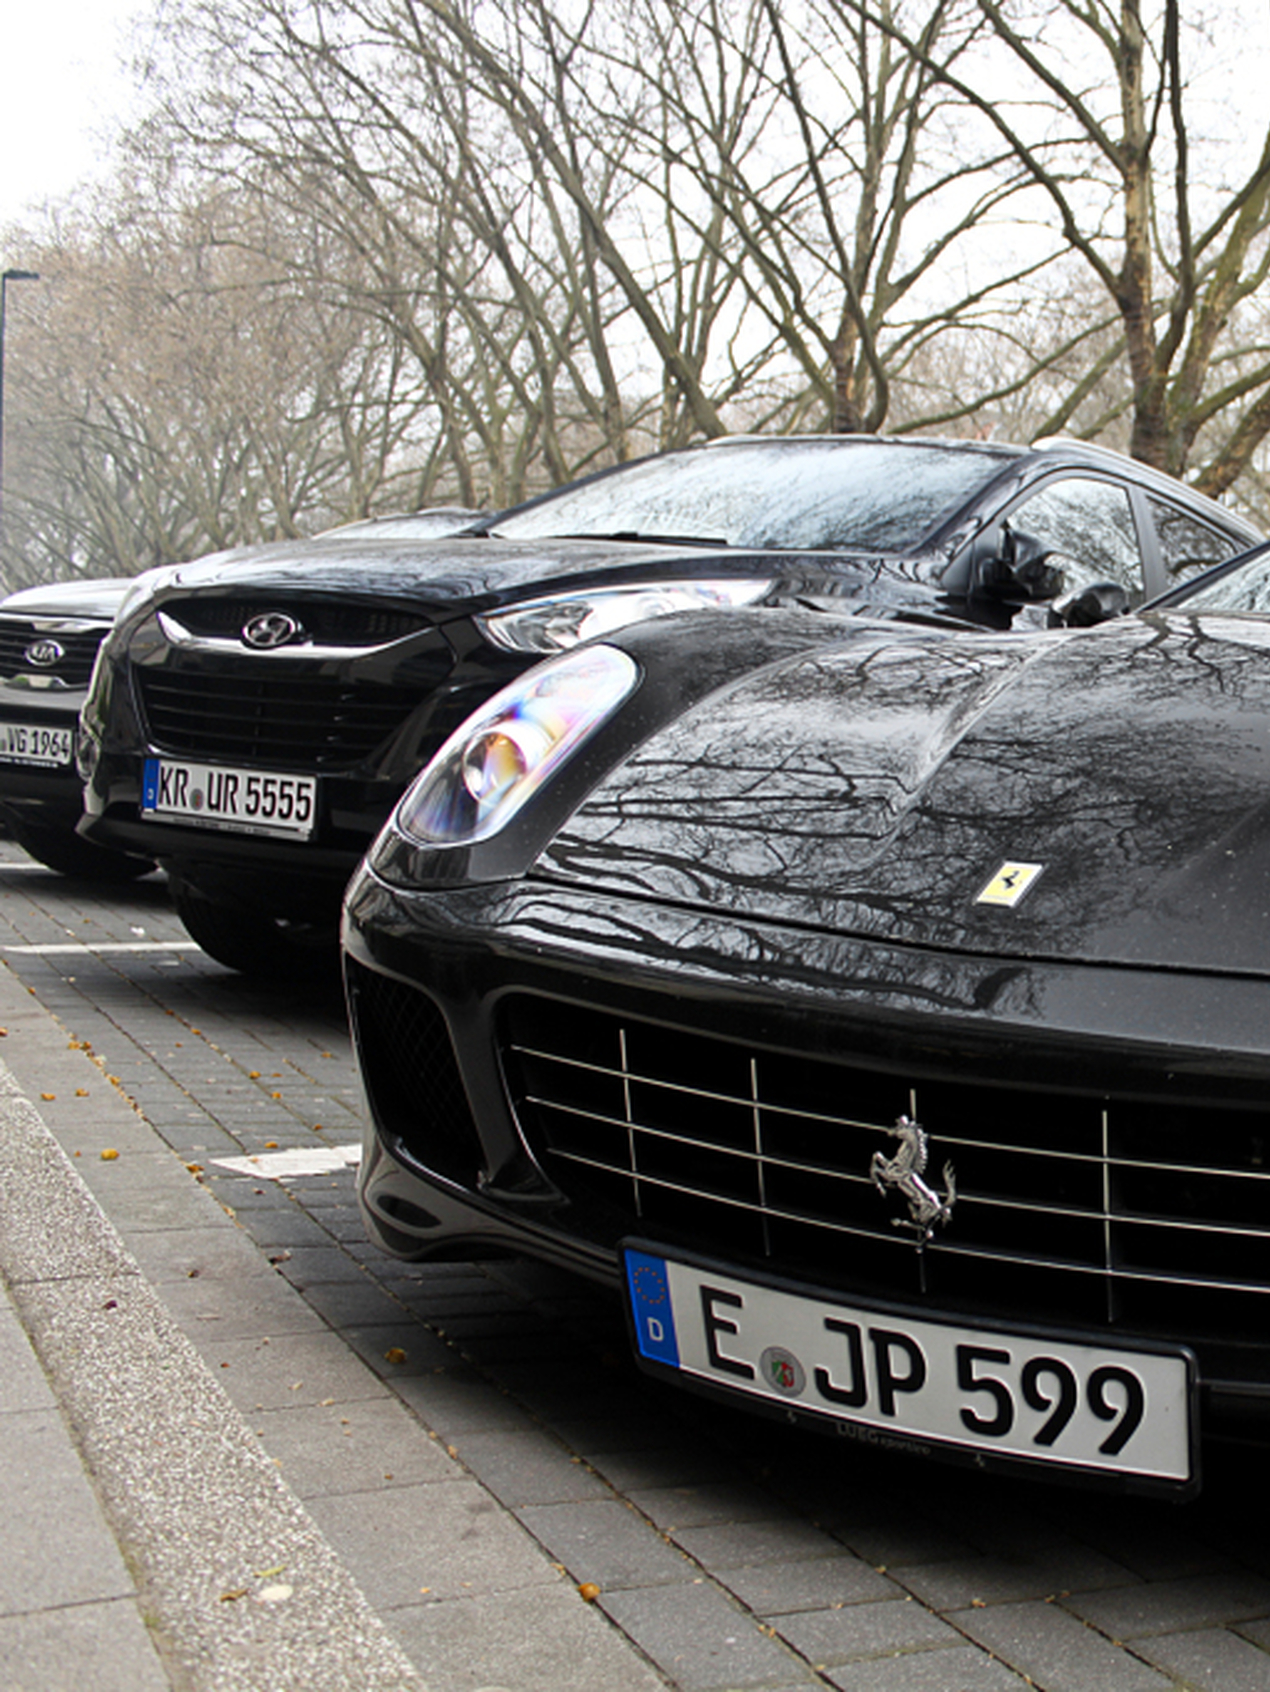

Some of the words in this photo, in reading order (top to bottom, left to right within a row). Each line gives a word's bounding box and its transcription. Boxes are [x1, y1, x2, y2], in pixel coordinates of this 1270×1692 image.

[30, 730, 69, 759] 1964
[159, 766, 189, 807] KR
[207, 772, 239, 814] UR
[245, 776, 312, 822] 5555
[647, 1317, 664, 1341] D
[699, 1285, 756, 1381] E
[814, 1317, 927, 1417] JP
[956, 1344, 1145, 1456] 599
